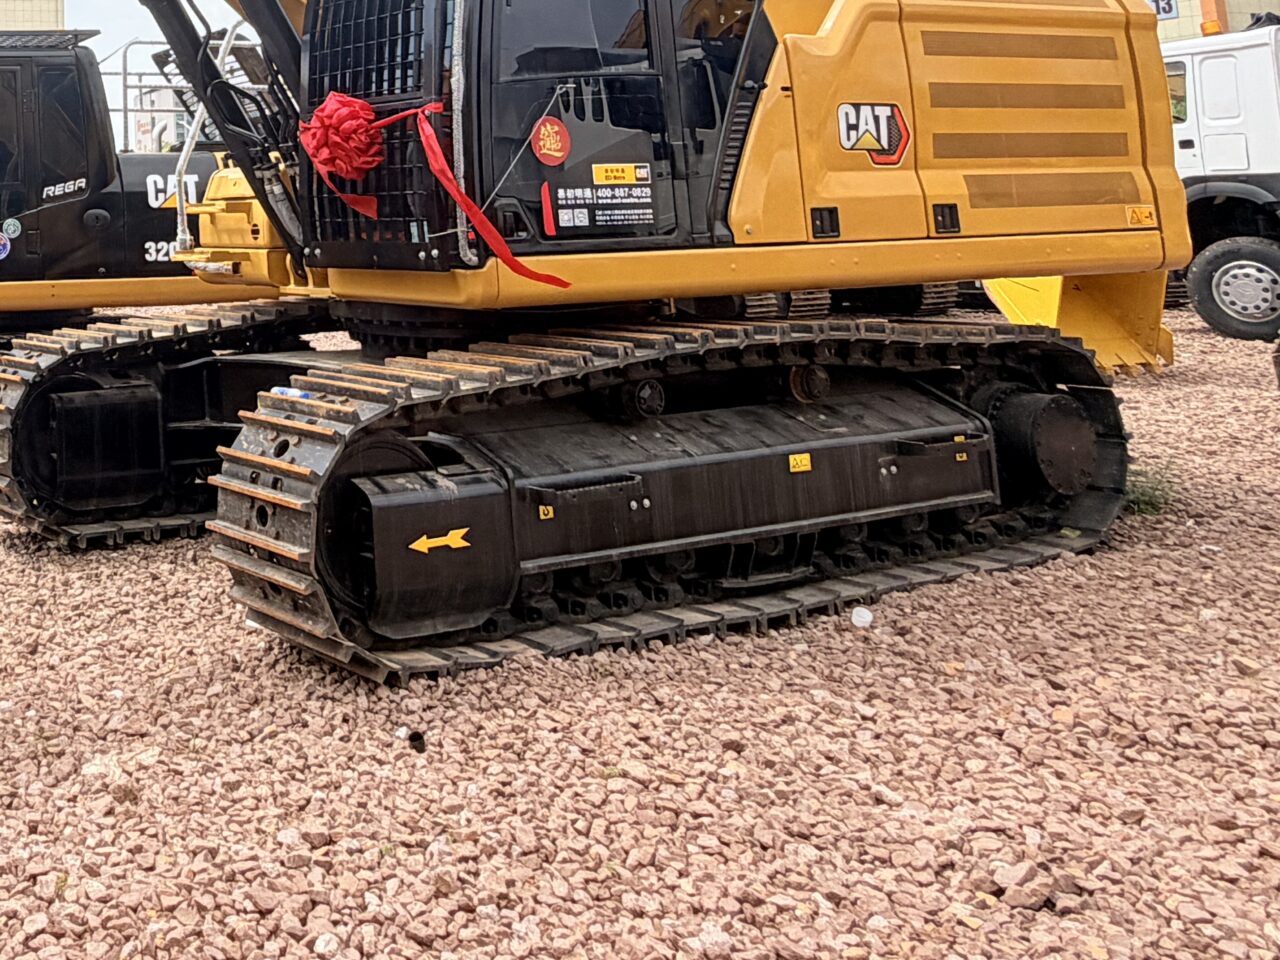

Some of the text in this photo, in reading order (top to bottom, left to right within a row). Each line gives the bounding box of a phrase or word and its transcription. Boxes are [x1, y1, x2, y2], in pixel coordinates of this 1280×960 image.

[837, 103, 892, 150] CAT
[42, 178, 86, 199] REGA
[146, 174, 199, 208] CAT
[597, 188, 651, 198] 400-887-0829
